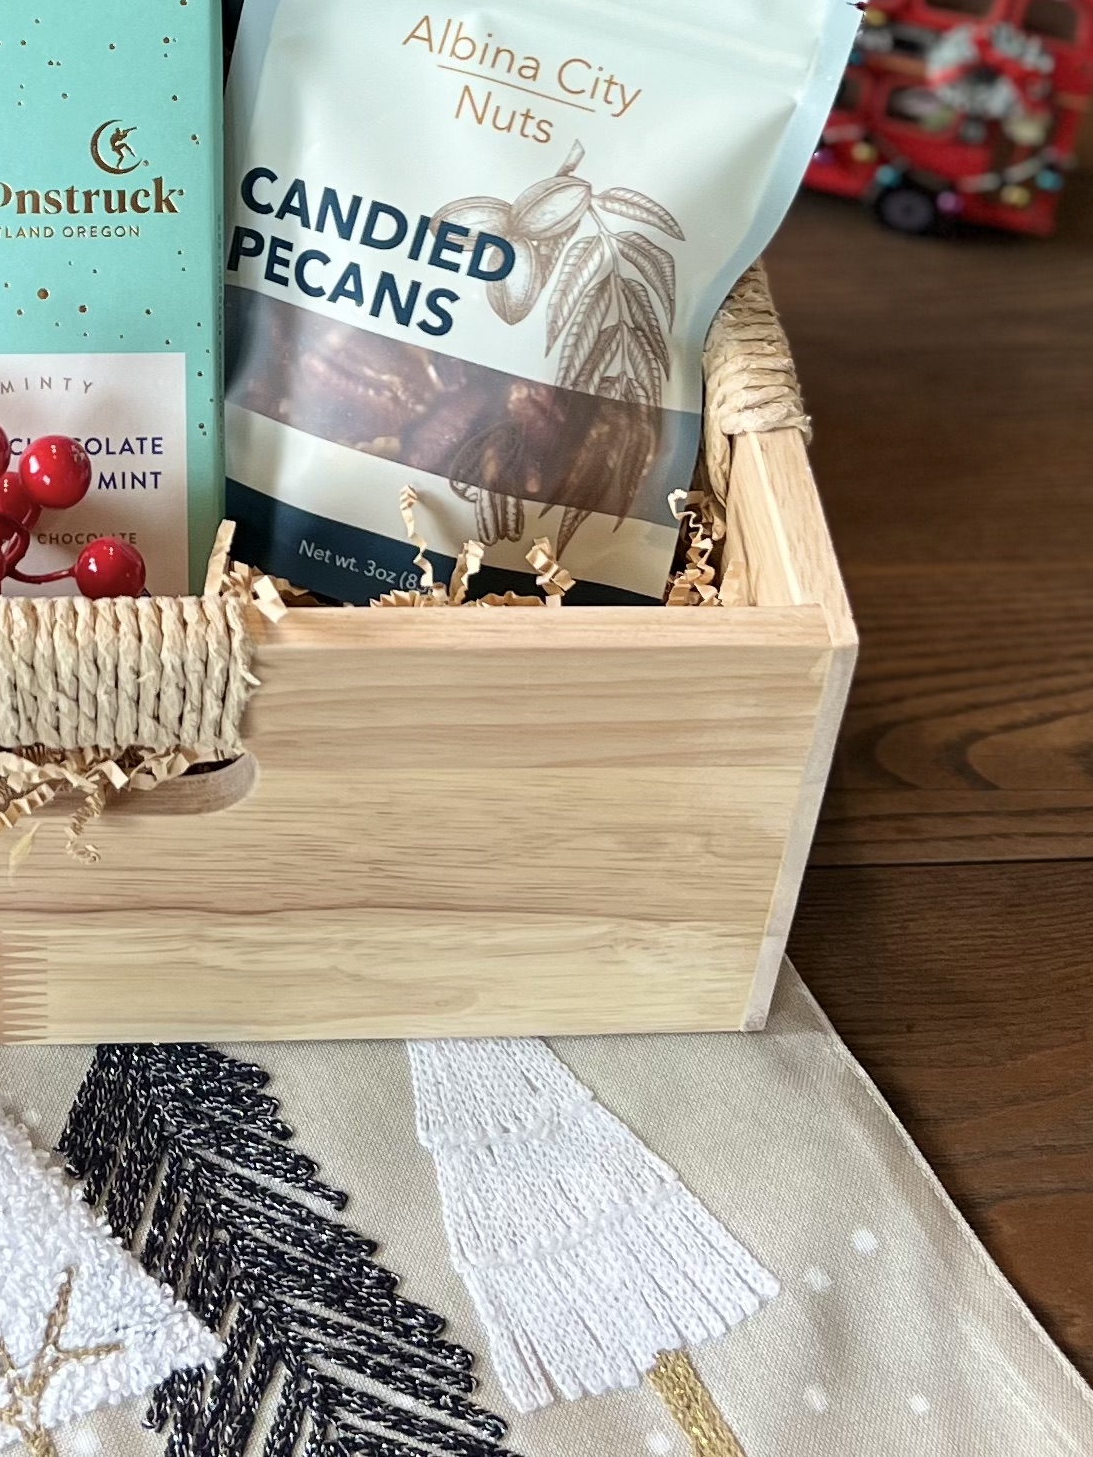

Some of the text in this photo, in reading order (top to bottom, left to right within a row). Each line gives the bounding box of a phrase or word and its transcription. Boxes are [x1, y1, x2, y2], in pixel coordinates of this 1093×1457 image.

[402, 14, 642, 118] Albina City
[454, 85, 554, 144] Nuts
[62, 224, 141, 239] OREGON
[240, 166, 516, 282] CANDIED
[226, 225, 461, 337] PECANS
[0, 376, 93, 395] MINTY
[10, 436, 164, 456] COLATE
[97, 471, 163, 490] MINT
[37, 532, 138, 545] CHOCOTE
[298, 539, 332, 563] Net
[335, 554, 360, 573] wt.
[363, 559, 397, 584] 3oz
